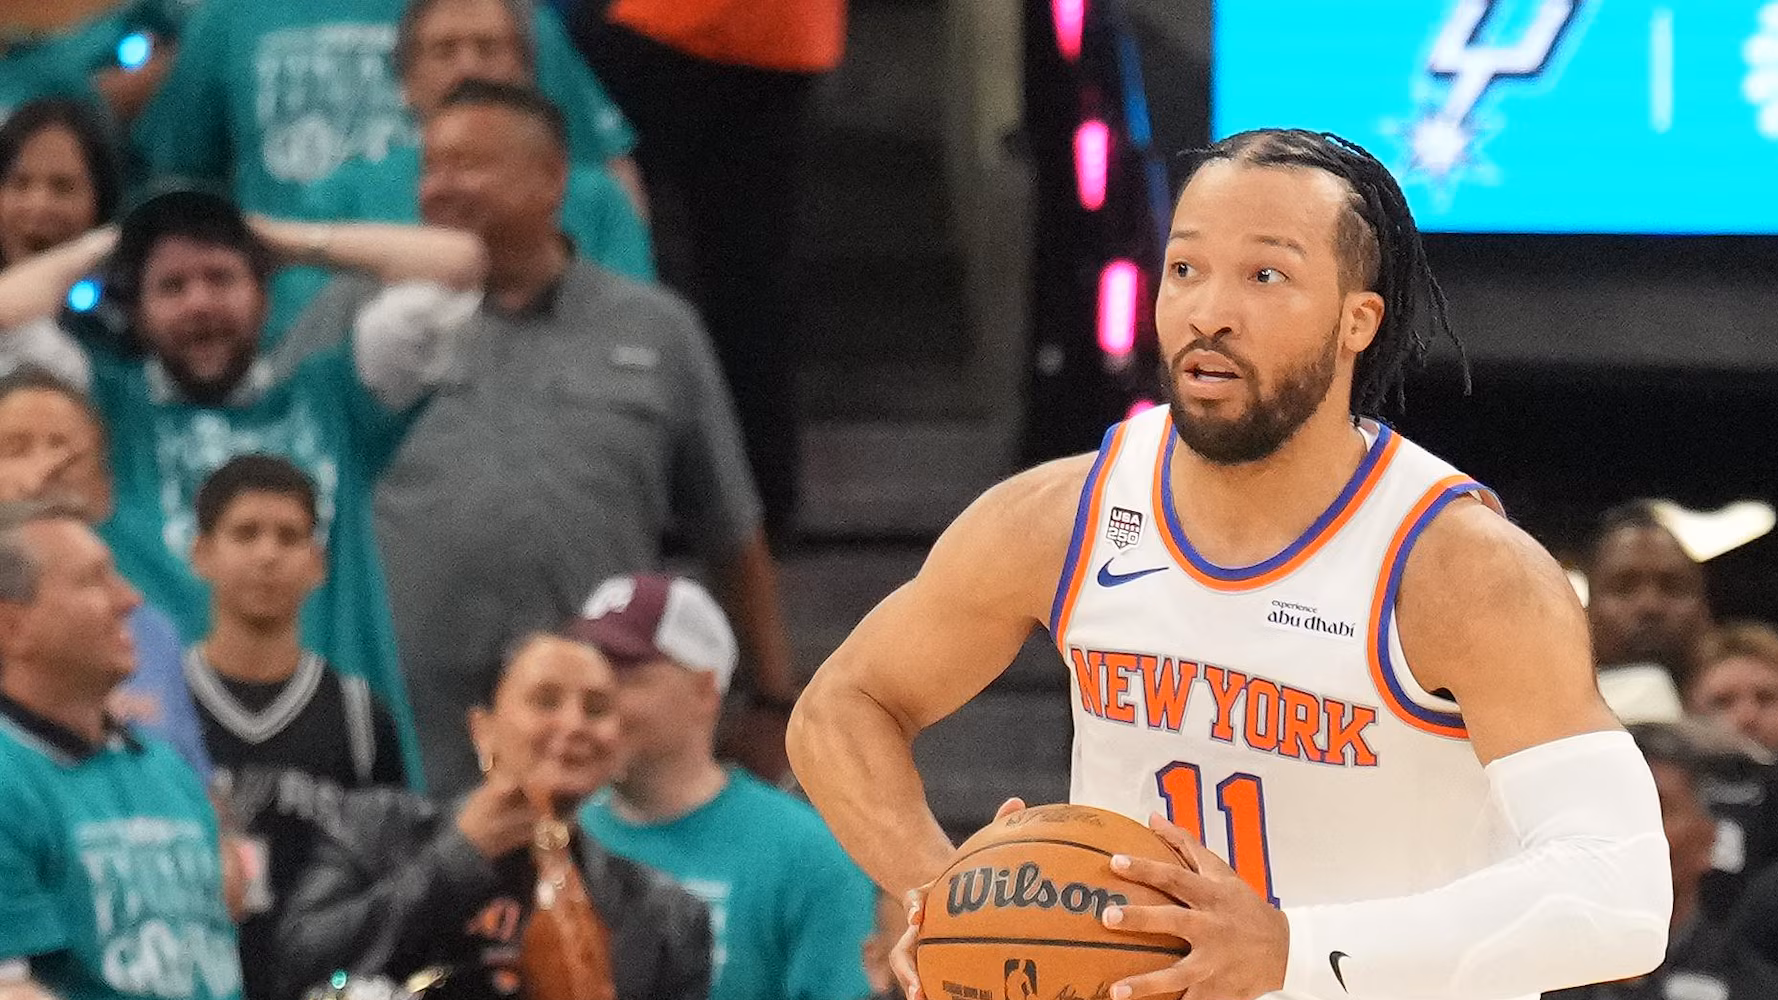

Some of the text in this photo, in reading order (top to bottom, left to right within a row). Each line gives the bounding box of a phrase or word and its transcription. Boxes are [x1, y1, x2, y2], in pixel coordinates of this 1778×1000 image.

[1112, 509, 1140, 526] USA
[1107, 526, 1139, 545] 250
[1267, 610, 1356, 637] abu dhabi
[1070, 646, 1379, 767] NEW YORK
[1155, 760, 1280, 910] 11
